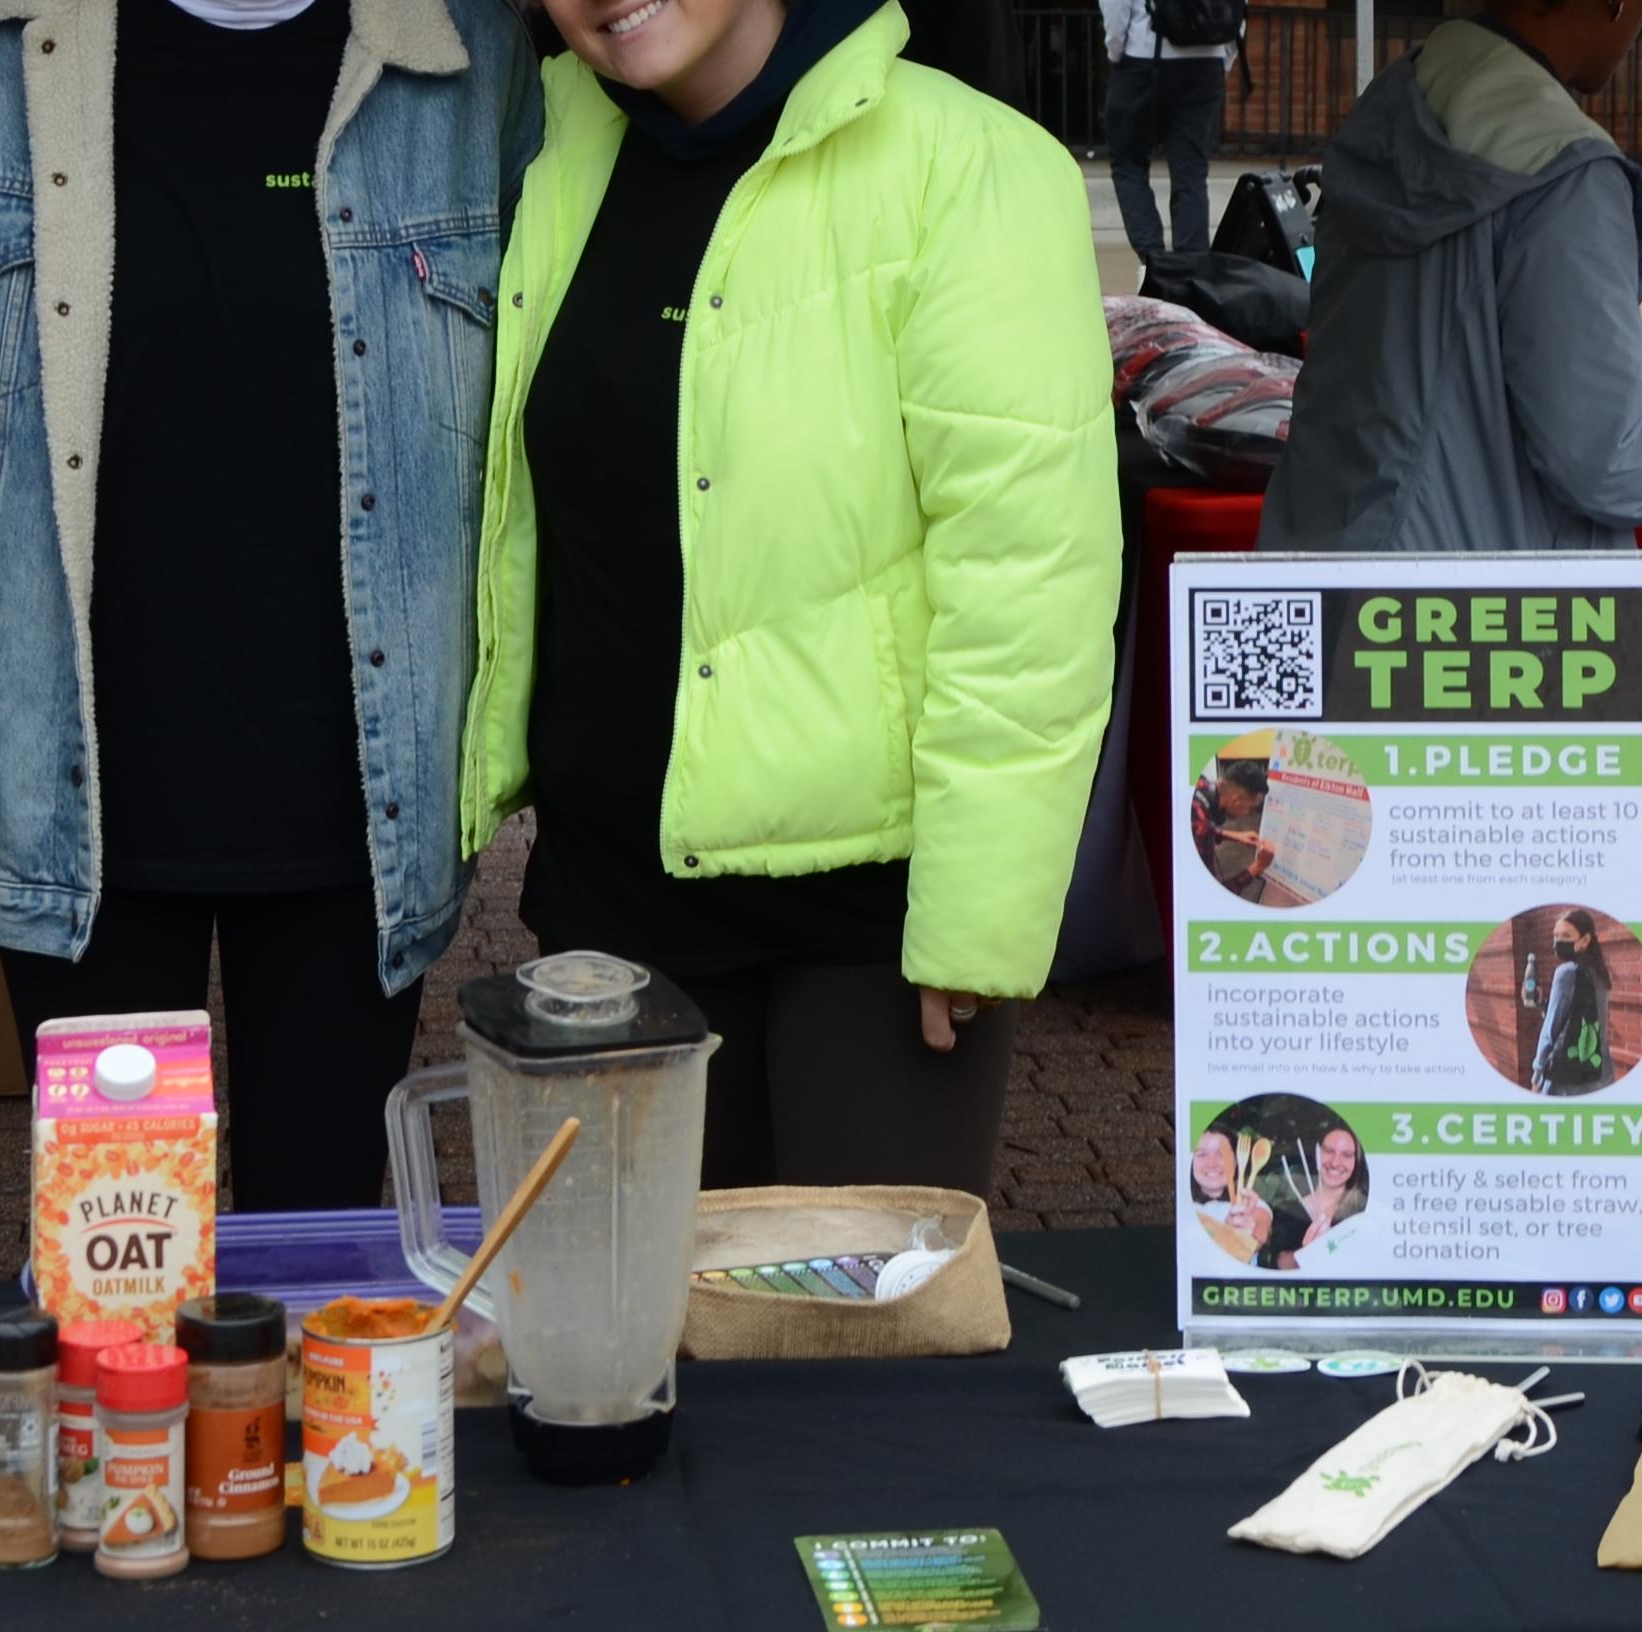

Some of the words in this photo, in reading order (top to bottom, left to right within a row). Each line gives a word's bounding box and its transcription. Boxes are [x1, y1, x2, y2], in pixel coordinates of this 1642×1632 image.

[266, 171, 314, 188] sust
[661, 306, 686, 322] su
[1358, 596, 1616, 644] GREEN
[1354, 650, 1617, 709] TERP
[1383, 744, 1622, 777] 1.PLEDGE
[1389, 800, 1484, 821] commit
[1491, 802, 1514, 821] to
[1521, 802, 1545, 821] at
[1551, 801, 1607, 821] least
[1613, 802, 1639, 821] 10
[1389, 825, 1525, 845] sustainable
[1531, 825, 1618, 845] actions
[1390, 848, 1446, 869] from
[1453, 849, 1493, 869] the
[1499, 849, 1606, 869] checklist
[1410, 873, 1439, 884] least
[1441, 875, 1464, 884] one
[1467, 873, 1496, 884] from
[1499, 873, 1528, 885] each
[1199, 931, 1471, 964] 2.ACTIONS
[1207, 983, 1345, 1007] incorporate
[1213, 1007, 1348, 1028] sustainable
[1354, 1008, 1440, 1029] actions
[1207, 1031, 1254, 1052] into
[1260, 1035, 1313, 1056] your
[1319, 1031, 1410, 1056] lifestyle
[1231, 1062, 1265, 1072] email
[1267, 1062, 1291, 1072] info
[1293, 1064, 1309, 1072] on
[1311, 1062, 1339, 1073] how
[1351, 1063, 1376, 1076] why
[1395, 1063, 1421, 1074] take
[80, 1120, 115, 1134] SUGAR
[143, 1117, 196, 1132] CALORIES
[1392, 1169, 1467, 1193] certify
[1473, 1170, 1489, 1188] &
[1495, 1170, 1564, 1189] select
[1571, 1170, 1628, 1190] from
[79, 1190, 179, 1223] PLANET
[1392, 1196, 1405, 1212] a
[1413, 1193, 1458, 1212] free
[1465, 1194, 1566, 1213] reusable
[1393, 1217, 1471, 1235] utensil
[1479, 1218, 1518, 1238] set,
[1525, 1222, 1549, 1237] or
[1557, 1219, 1603, 1237] tree
[86, 1233, 173, 1271] OAT
[1392, 1240, 1501, 1260] donation
[93, 1275, 166, 1297] OATMILK
[1202, 1285, 1515, 1309] GREENTERP.UMD.EDU
[228, 1462, 275, 1481] Ground
[832, 1536, 934, 1550] COMMIT
